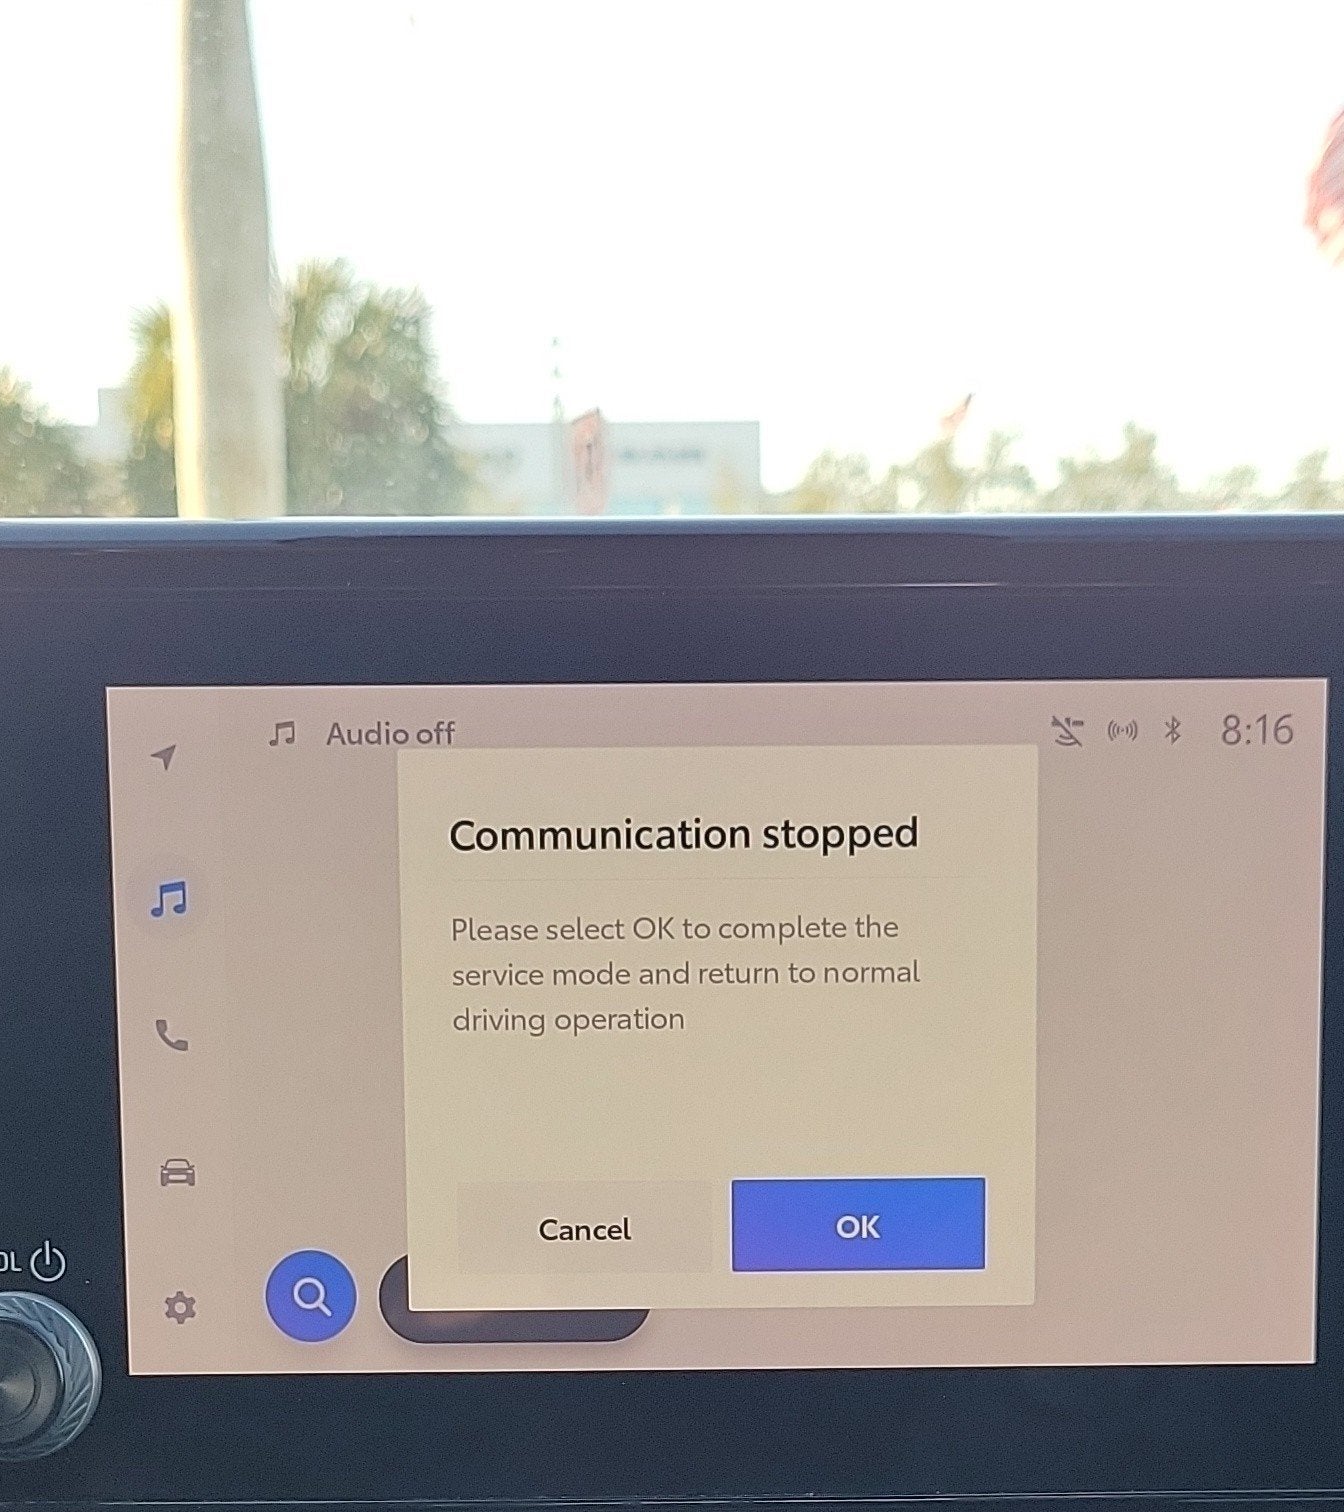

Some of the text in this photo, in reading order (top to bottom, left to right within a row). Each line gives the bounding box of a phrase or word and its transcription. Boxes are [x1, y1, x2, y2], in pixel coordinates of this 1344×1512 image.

[325, 718, 456, 746] Audio off
[1221, 713, 1295, 747] 8:16
[449, 814, 919, 858] Communication stopped
[451, 912, 899, 947] Please select OK to complete the
[452, 958, 921, 988] service mode and return to normal
[452, 1005, 685, 1039] driving operation
[538, 1216, 632, 1242] Cancel
[835, 1214, 881, 1240] OK
